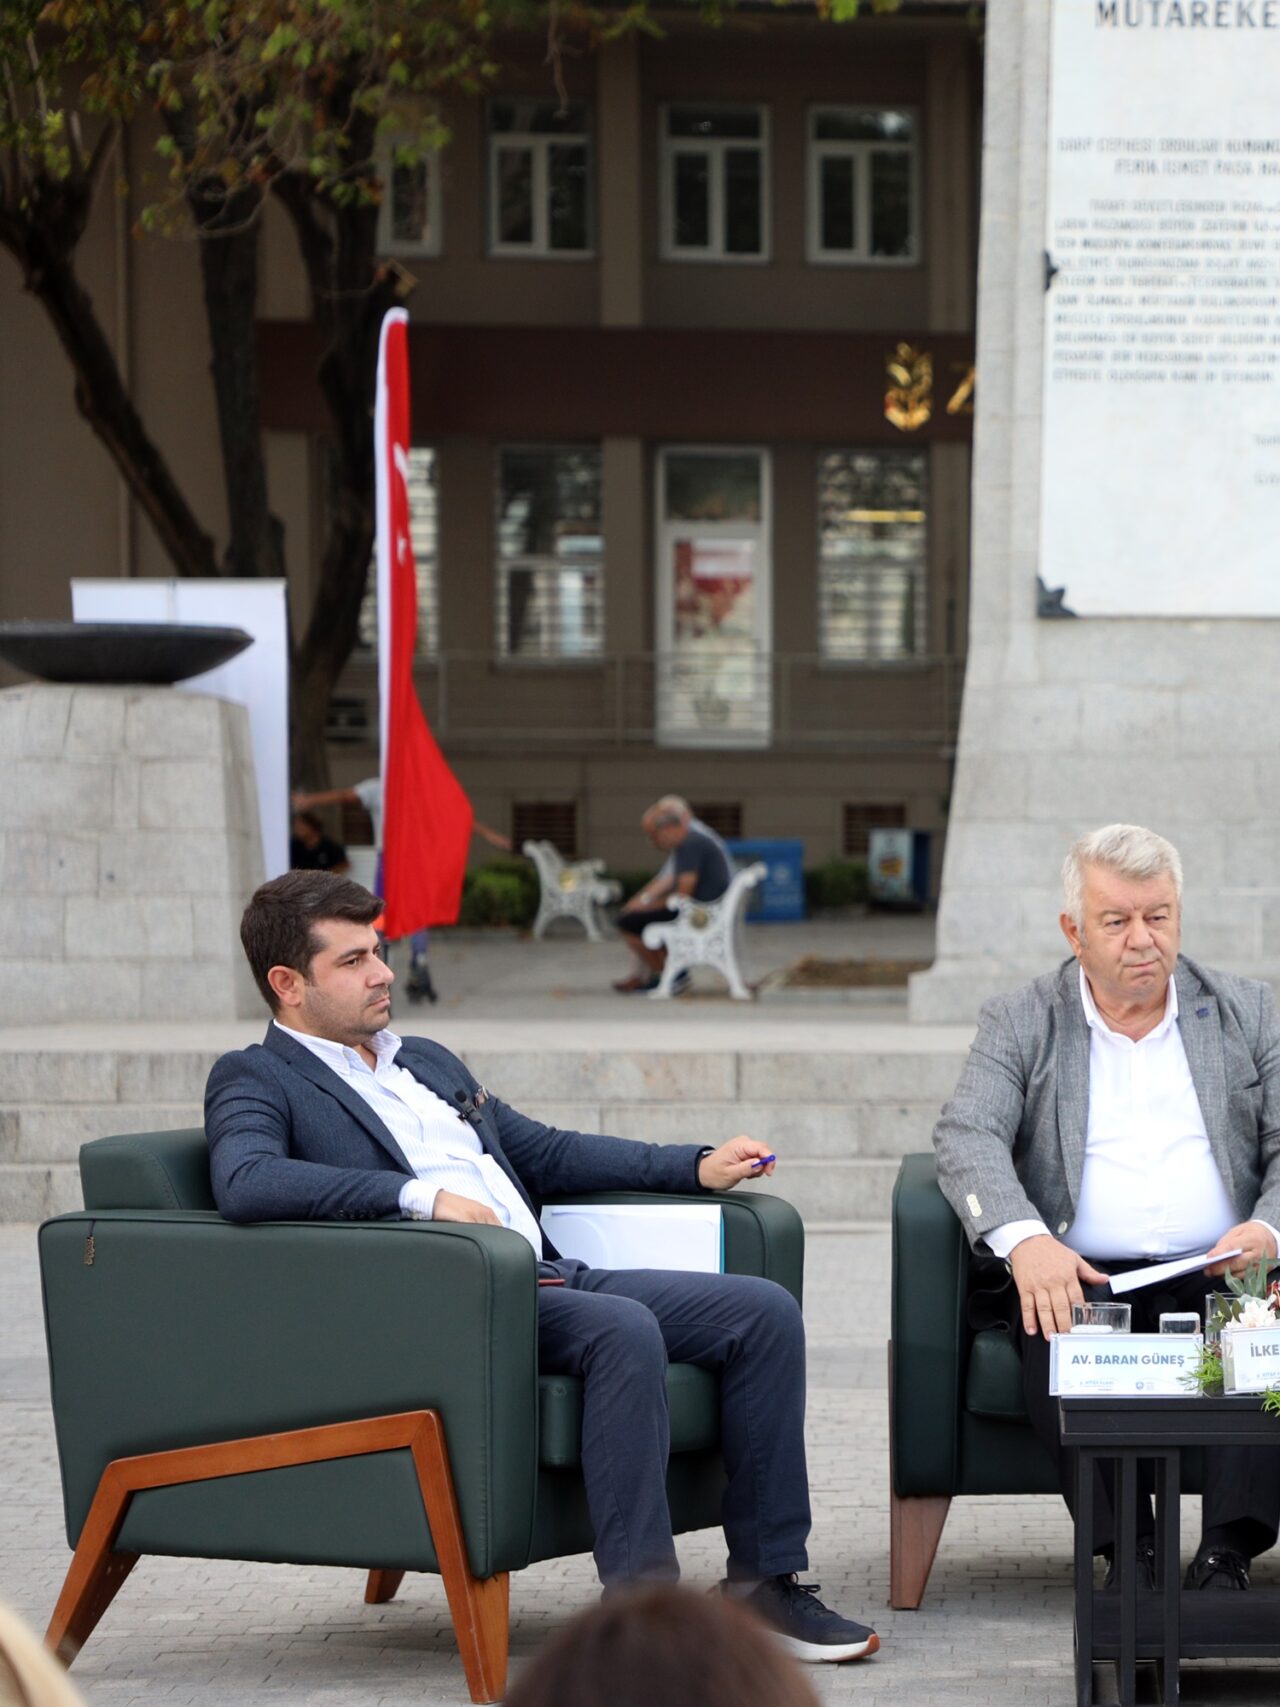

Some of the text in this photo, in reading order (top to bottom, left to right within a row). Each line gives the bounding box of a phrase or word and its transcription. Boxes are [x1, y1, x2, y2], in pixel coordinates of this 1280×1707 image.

[1071, 1352, 1185, 1368] AV. BARAN GÜNEŞ
